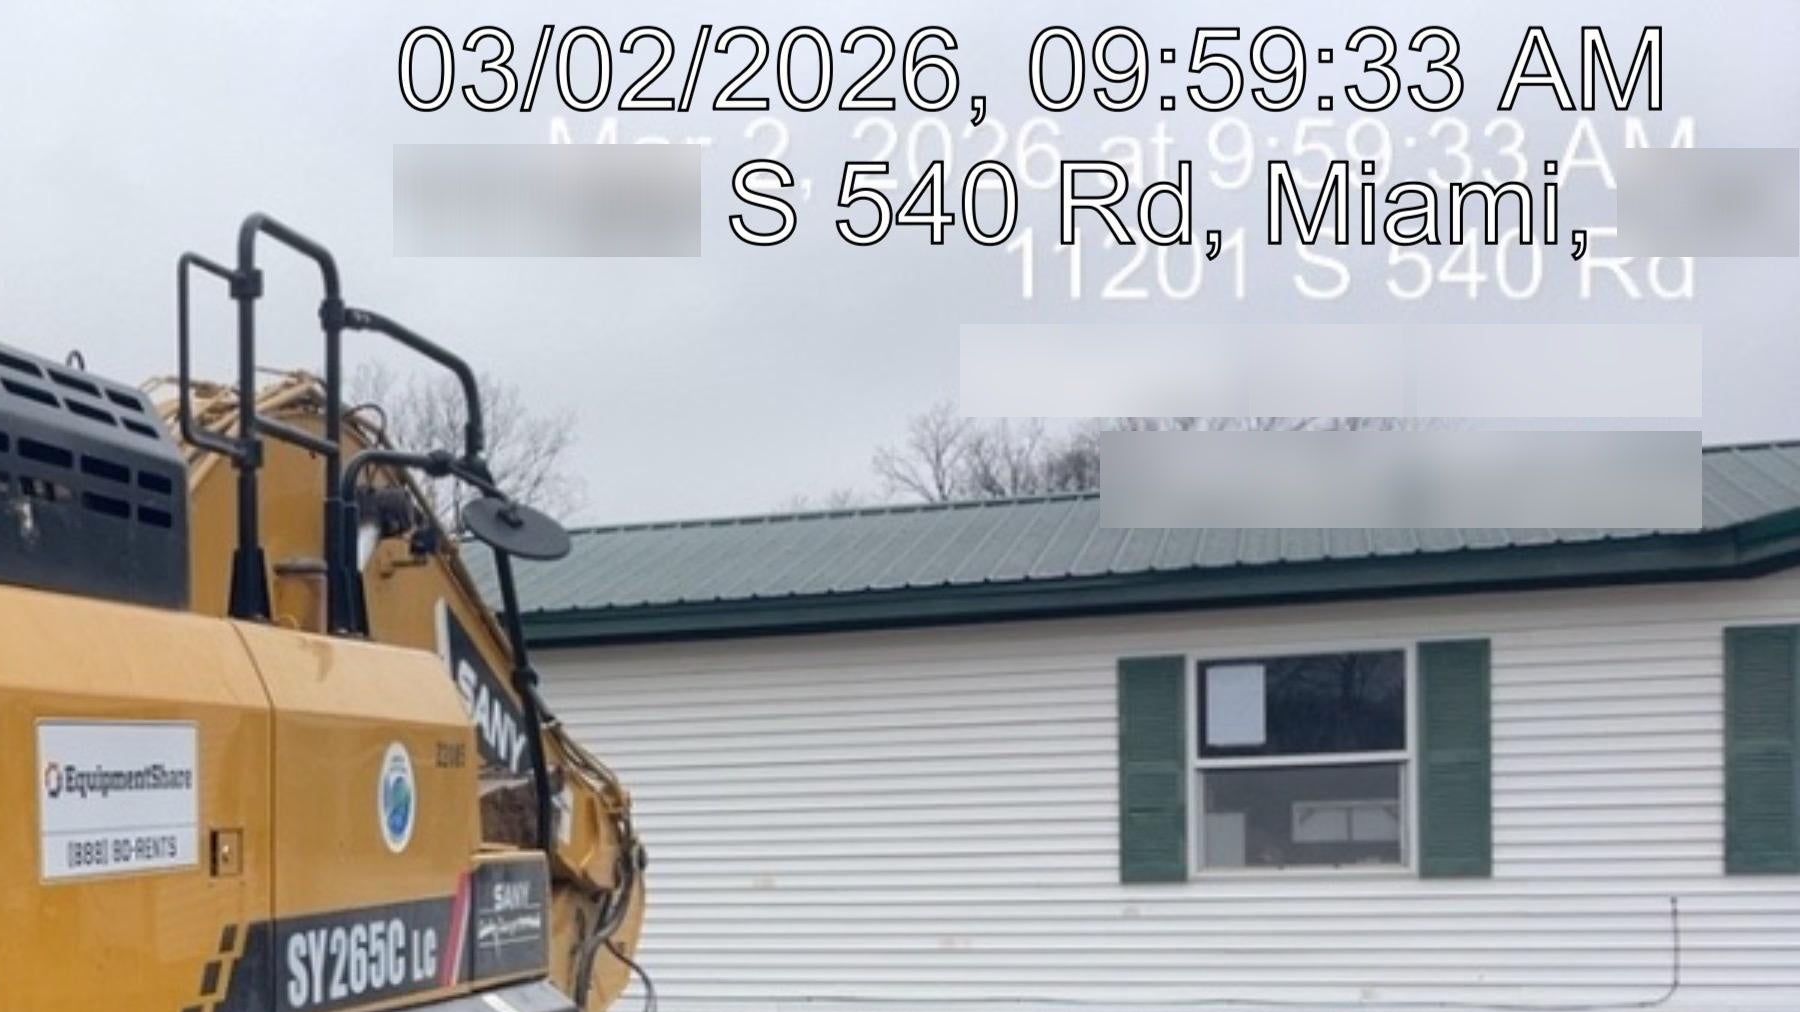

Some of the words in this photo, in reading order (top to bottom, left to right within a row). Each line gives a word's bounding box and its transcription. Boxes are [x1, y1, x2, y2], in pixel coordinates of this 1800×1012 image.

[64, 764, 192, 798] EquipmentShare
[287, 918, 406, 1008] SY265C
[412, 928, 437, 982] LC
